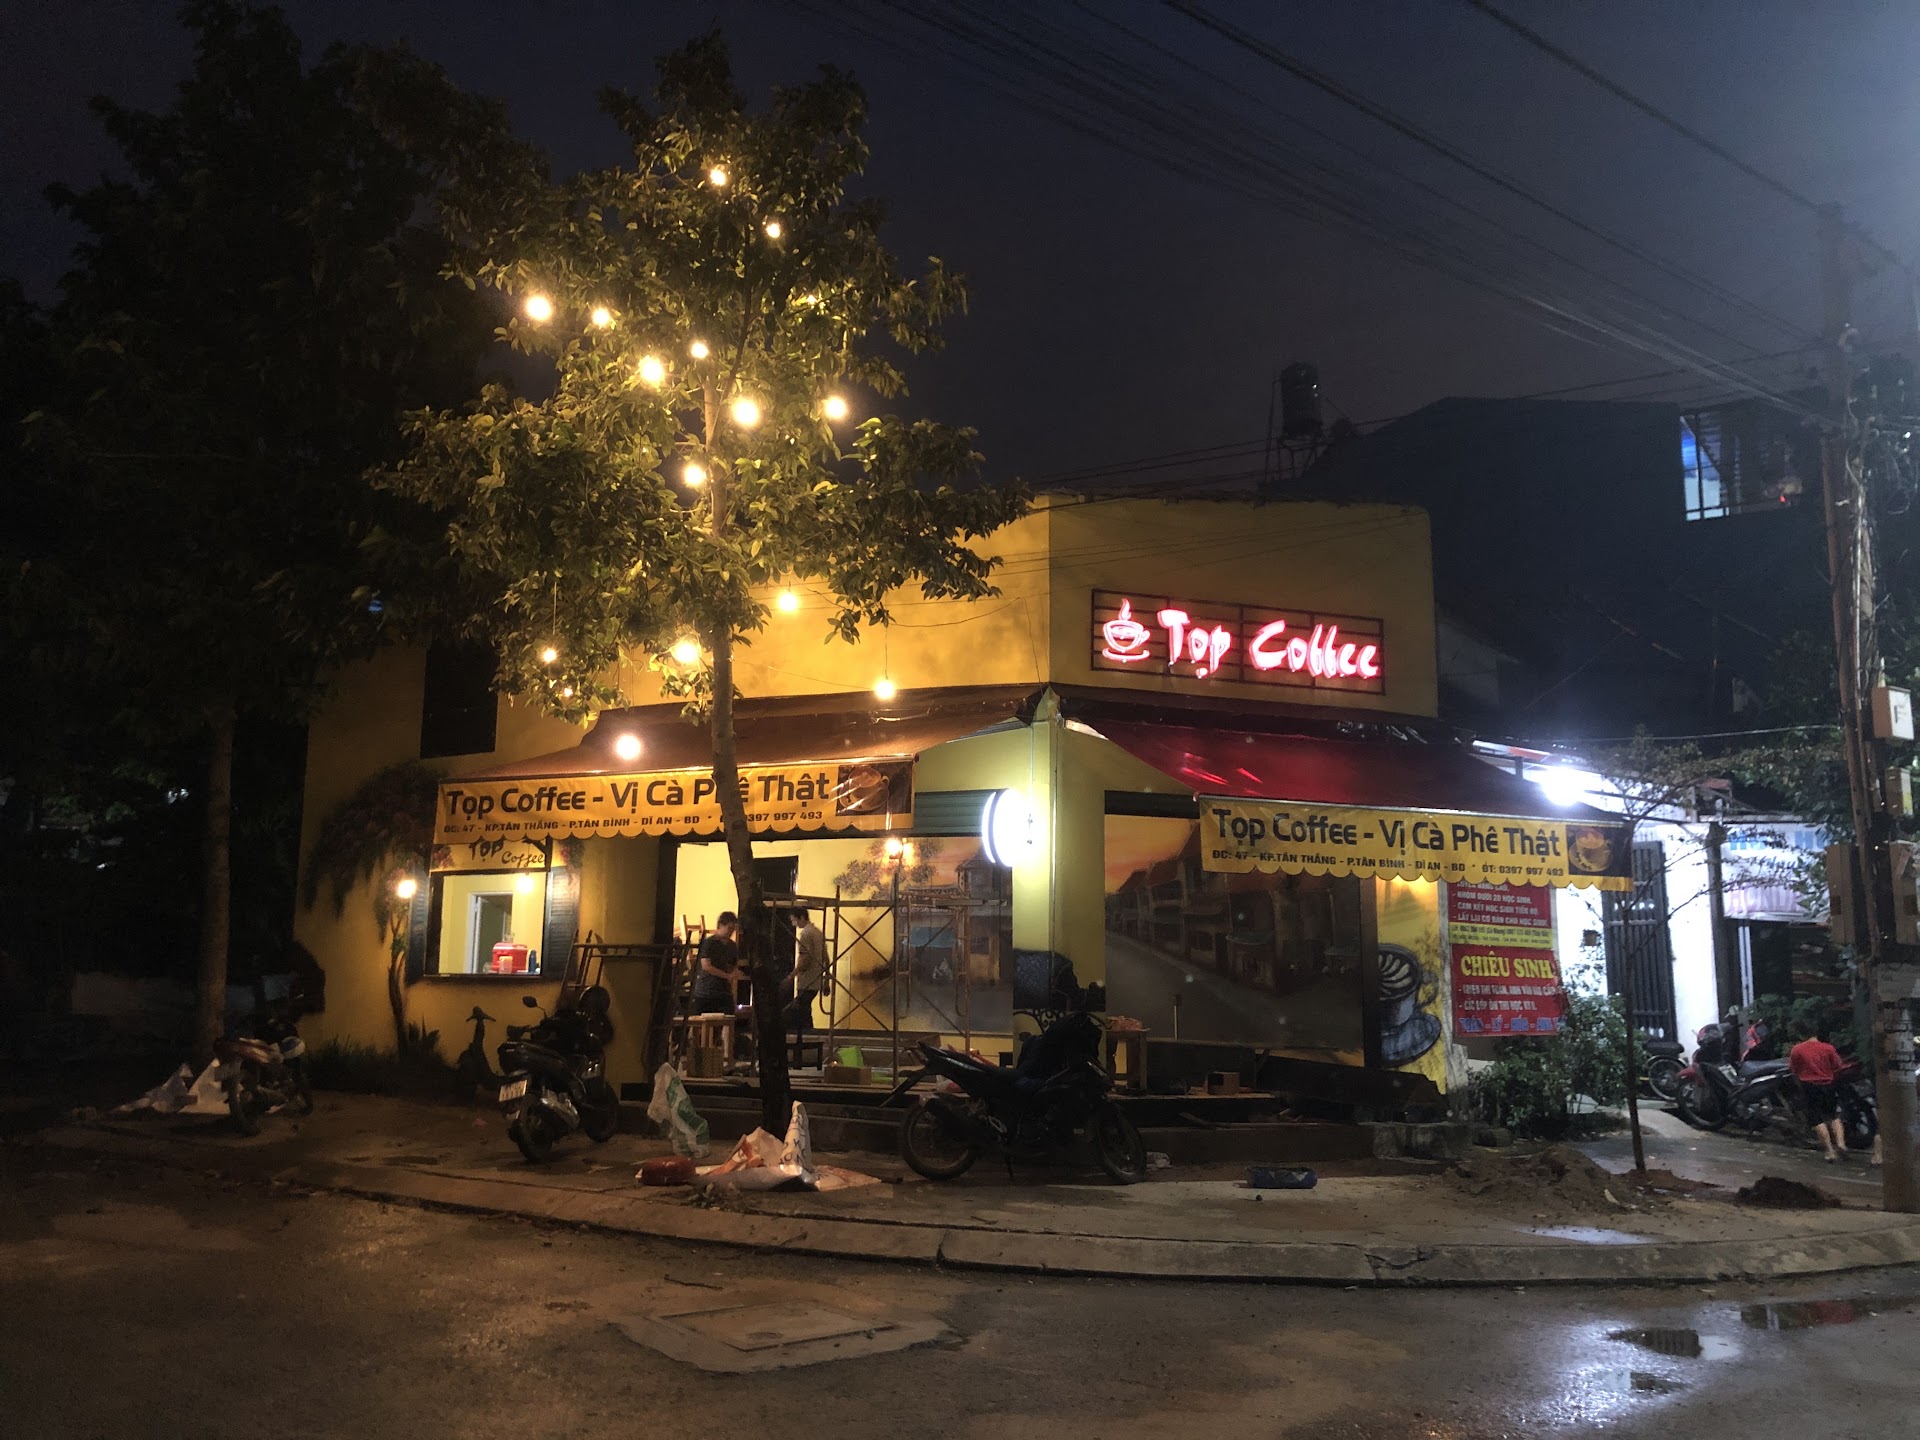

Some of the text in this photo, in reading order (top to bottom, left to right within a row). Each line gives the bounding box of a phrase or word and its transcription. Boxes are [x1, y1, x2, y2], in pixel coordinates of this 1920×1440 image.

[1249, 619, 1379, 679] Coffee
[501, 787, 586, 814] Coffee
[611, 782, 639, 814] Vị
[647, 780, 684, 807] Cà
[758, 773, 830, 808] Thật
[462, 824, 475, 833] 47
[603, 816, 630, 828] BÌNH
[656, 816, 673, 825] AN
[684, 815, 700, 824] BD
[773, 811, 797, 821] 997
[800, 810, 823, 820] 493
[1272, 813, 1358, 847] Coffee
[1379, 820, 1406, 856] Vị
[1412, 822, 1445, 851] Cà
[1451, 824, 1500, 854] Phê
[1503, 828, 1562, 864] Thật
[502, 851, 546, 868] Coffee
[1427, 862, 1441, 871] AN
[1451, 863, 1466, 872] BD
[1513, 958, 1554, 979] SINH
